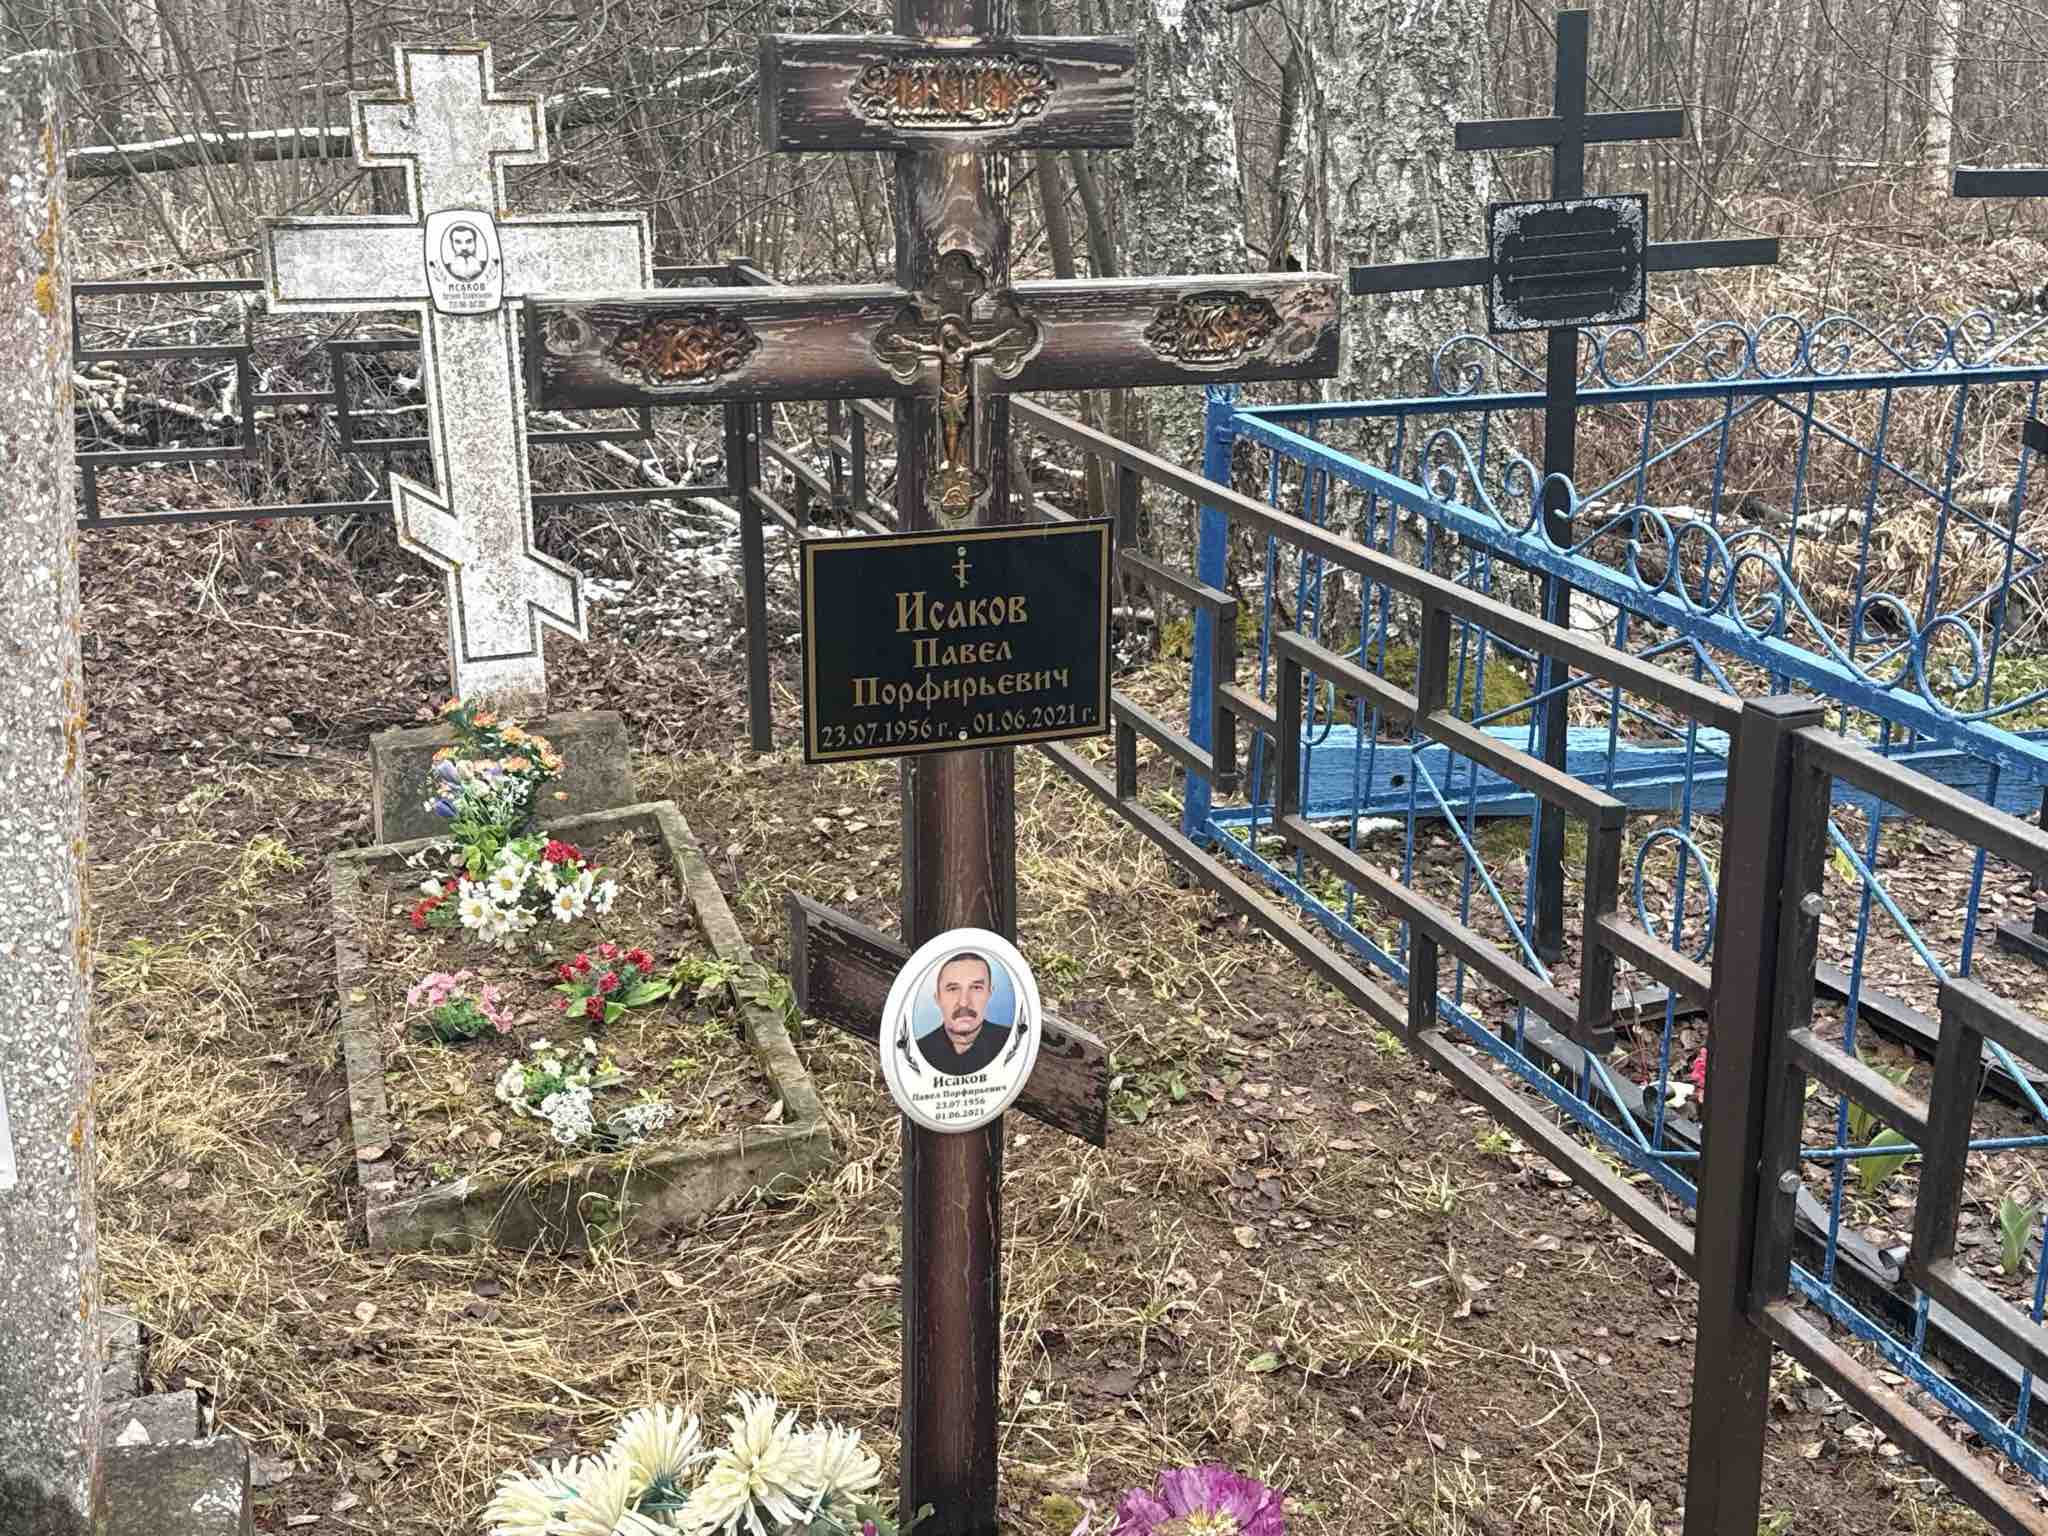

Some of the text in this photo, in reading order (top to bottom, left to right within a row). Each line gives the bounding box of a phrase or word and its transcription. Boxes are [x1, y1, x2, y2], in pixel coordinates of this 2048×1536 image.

[896, 591, 1028, 632] Исаков
[911, 638, 1013, 669] Павел
[852, 669, 1069, 712] Порфирьевич
[821, 719, 932, 747] 23.07.1956
[973, 703, 1076, 734] 01.06.2021
[933, 1074, 987, 1088] Исаков
